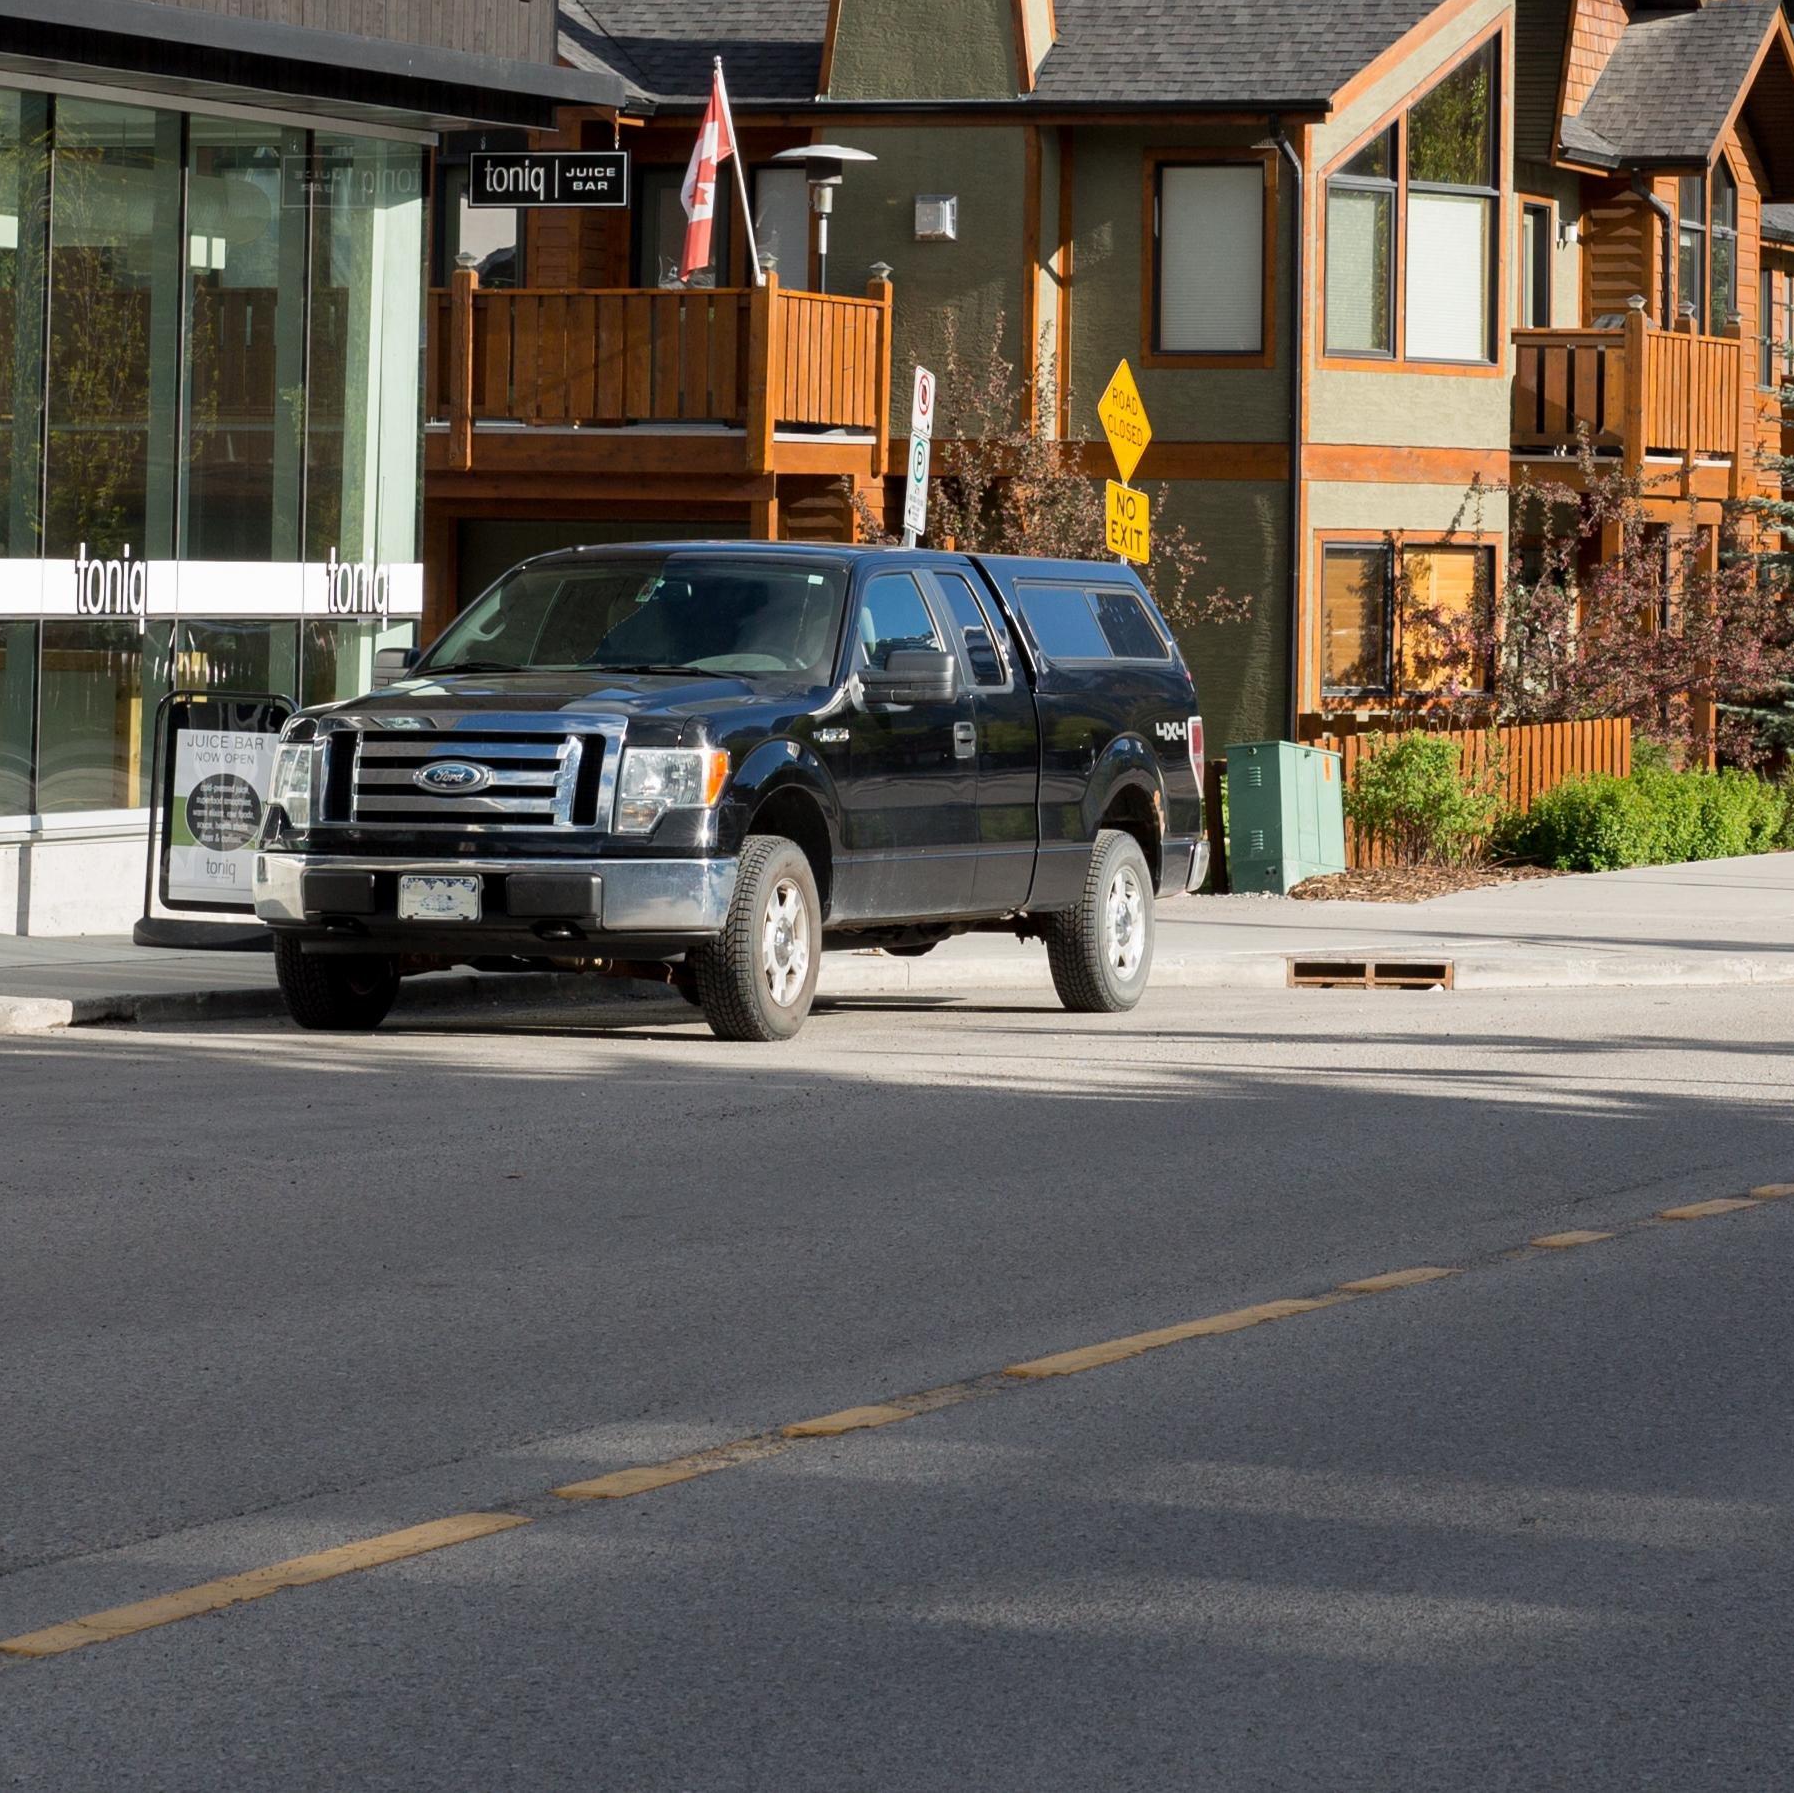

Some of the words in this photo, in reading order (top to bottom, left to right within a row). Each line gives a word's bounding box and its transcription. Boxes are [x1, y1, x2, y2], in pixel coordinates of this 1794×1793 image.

[484, 159, 545, 201] toniq
[565, 168, 615, 177] JUICE
[573, 181, 608, 190] BAR
[1112, 388, 1138, 416] ROAD
[1107, 414, 1143, 447] CLOSED
[1116, 492, 1137, 520] NO
[1111, 520, 1143, 553] EXIT
[75, 542, 146, 635] toniq
[326, 546, 389, 631] toniq
[187, 734, 229, 748] JUICE
[234, 736, 264, 750] BAR
[195, 752, 222, 763] NOW
[225, 753, 255, 765] OPEN
[434, 769, 465, 783] Ford
[206, 859, 237, 884] toniq
